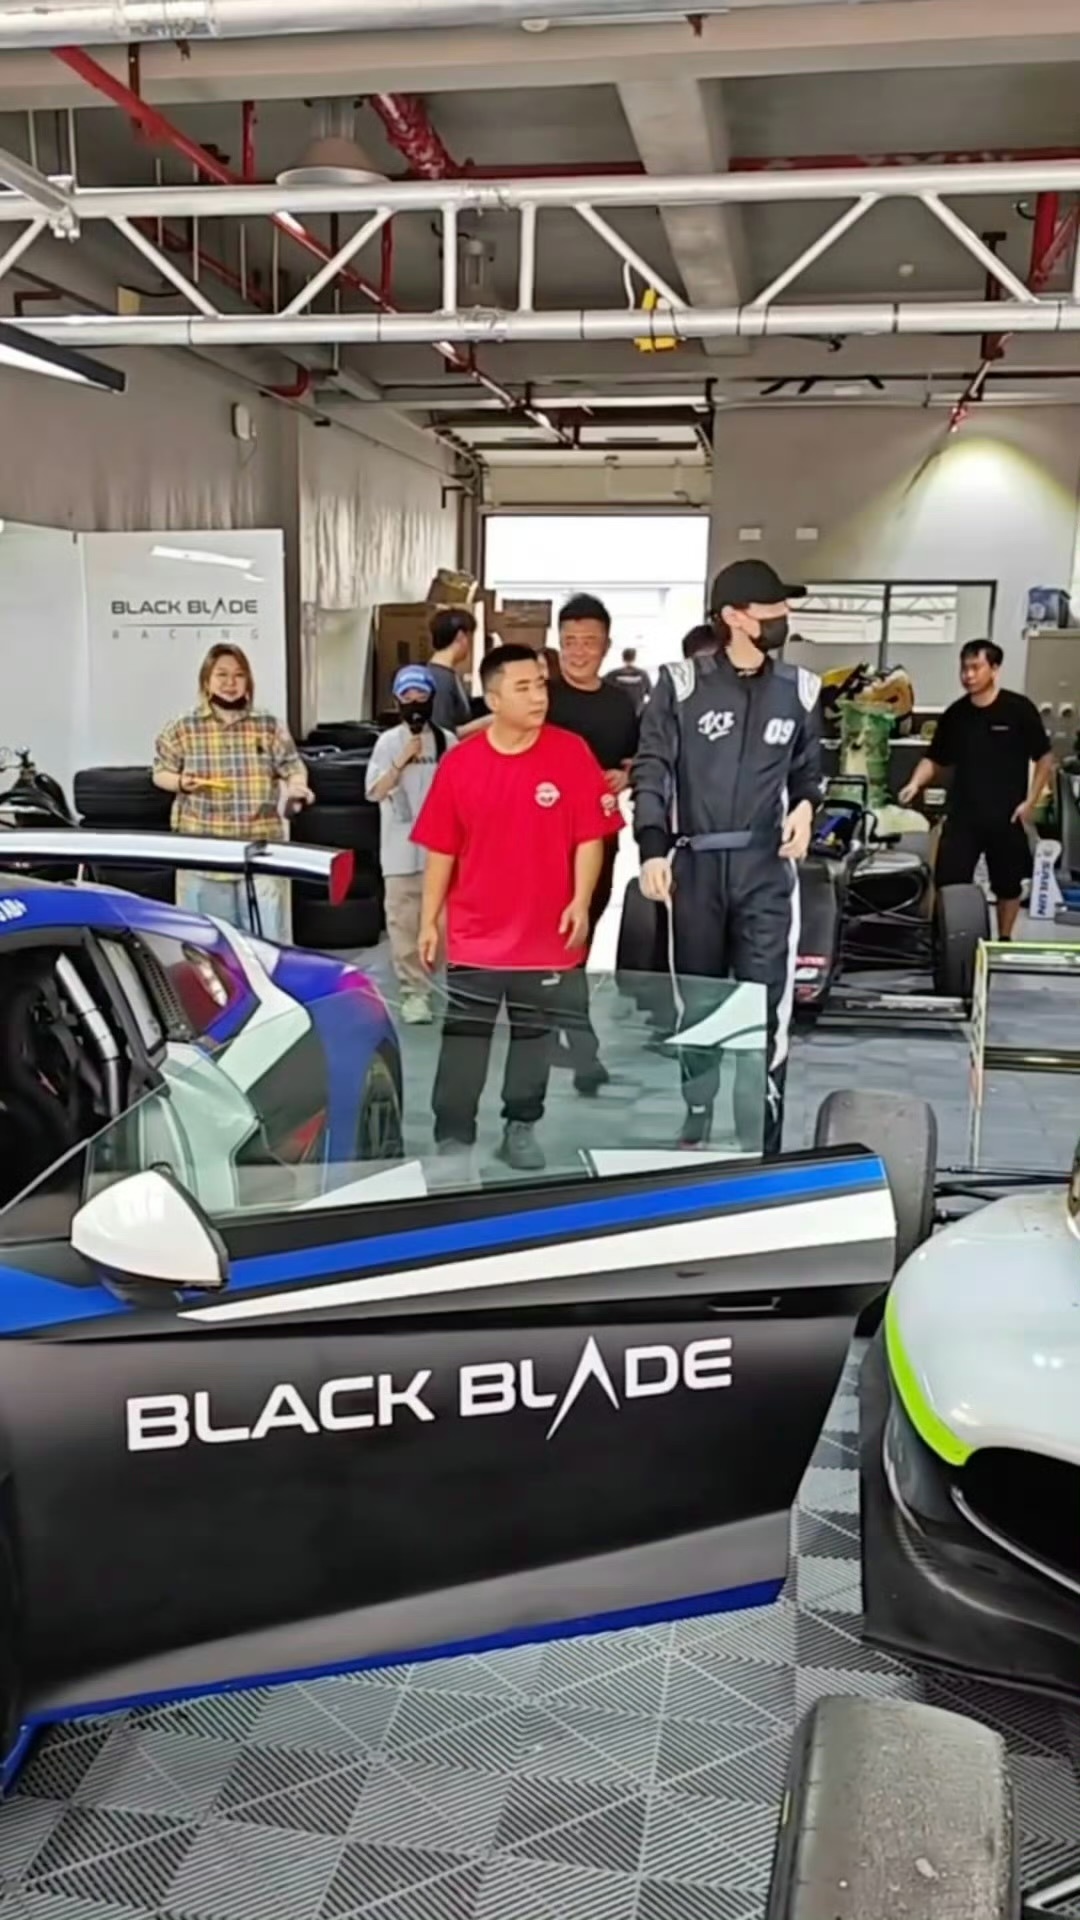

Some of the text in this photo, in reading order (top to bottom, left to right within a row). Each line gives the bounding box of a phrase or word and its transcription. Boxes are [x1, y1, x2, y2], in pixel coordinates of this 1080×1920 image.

[111, 597, 258, 620] BLACK BLADE
[763, 718, 796, 745] 09
[126, 1335, 734, 1452] BLACK BLADE
